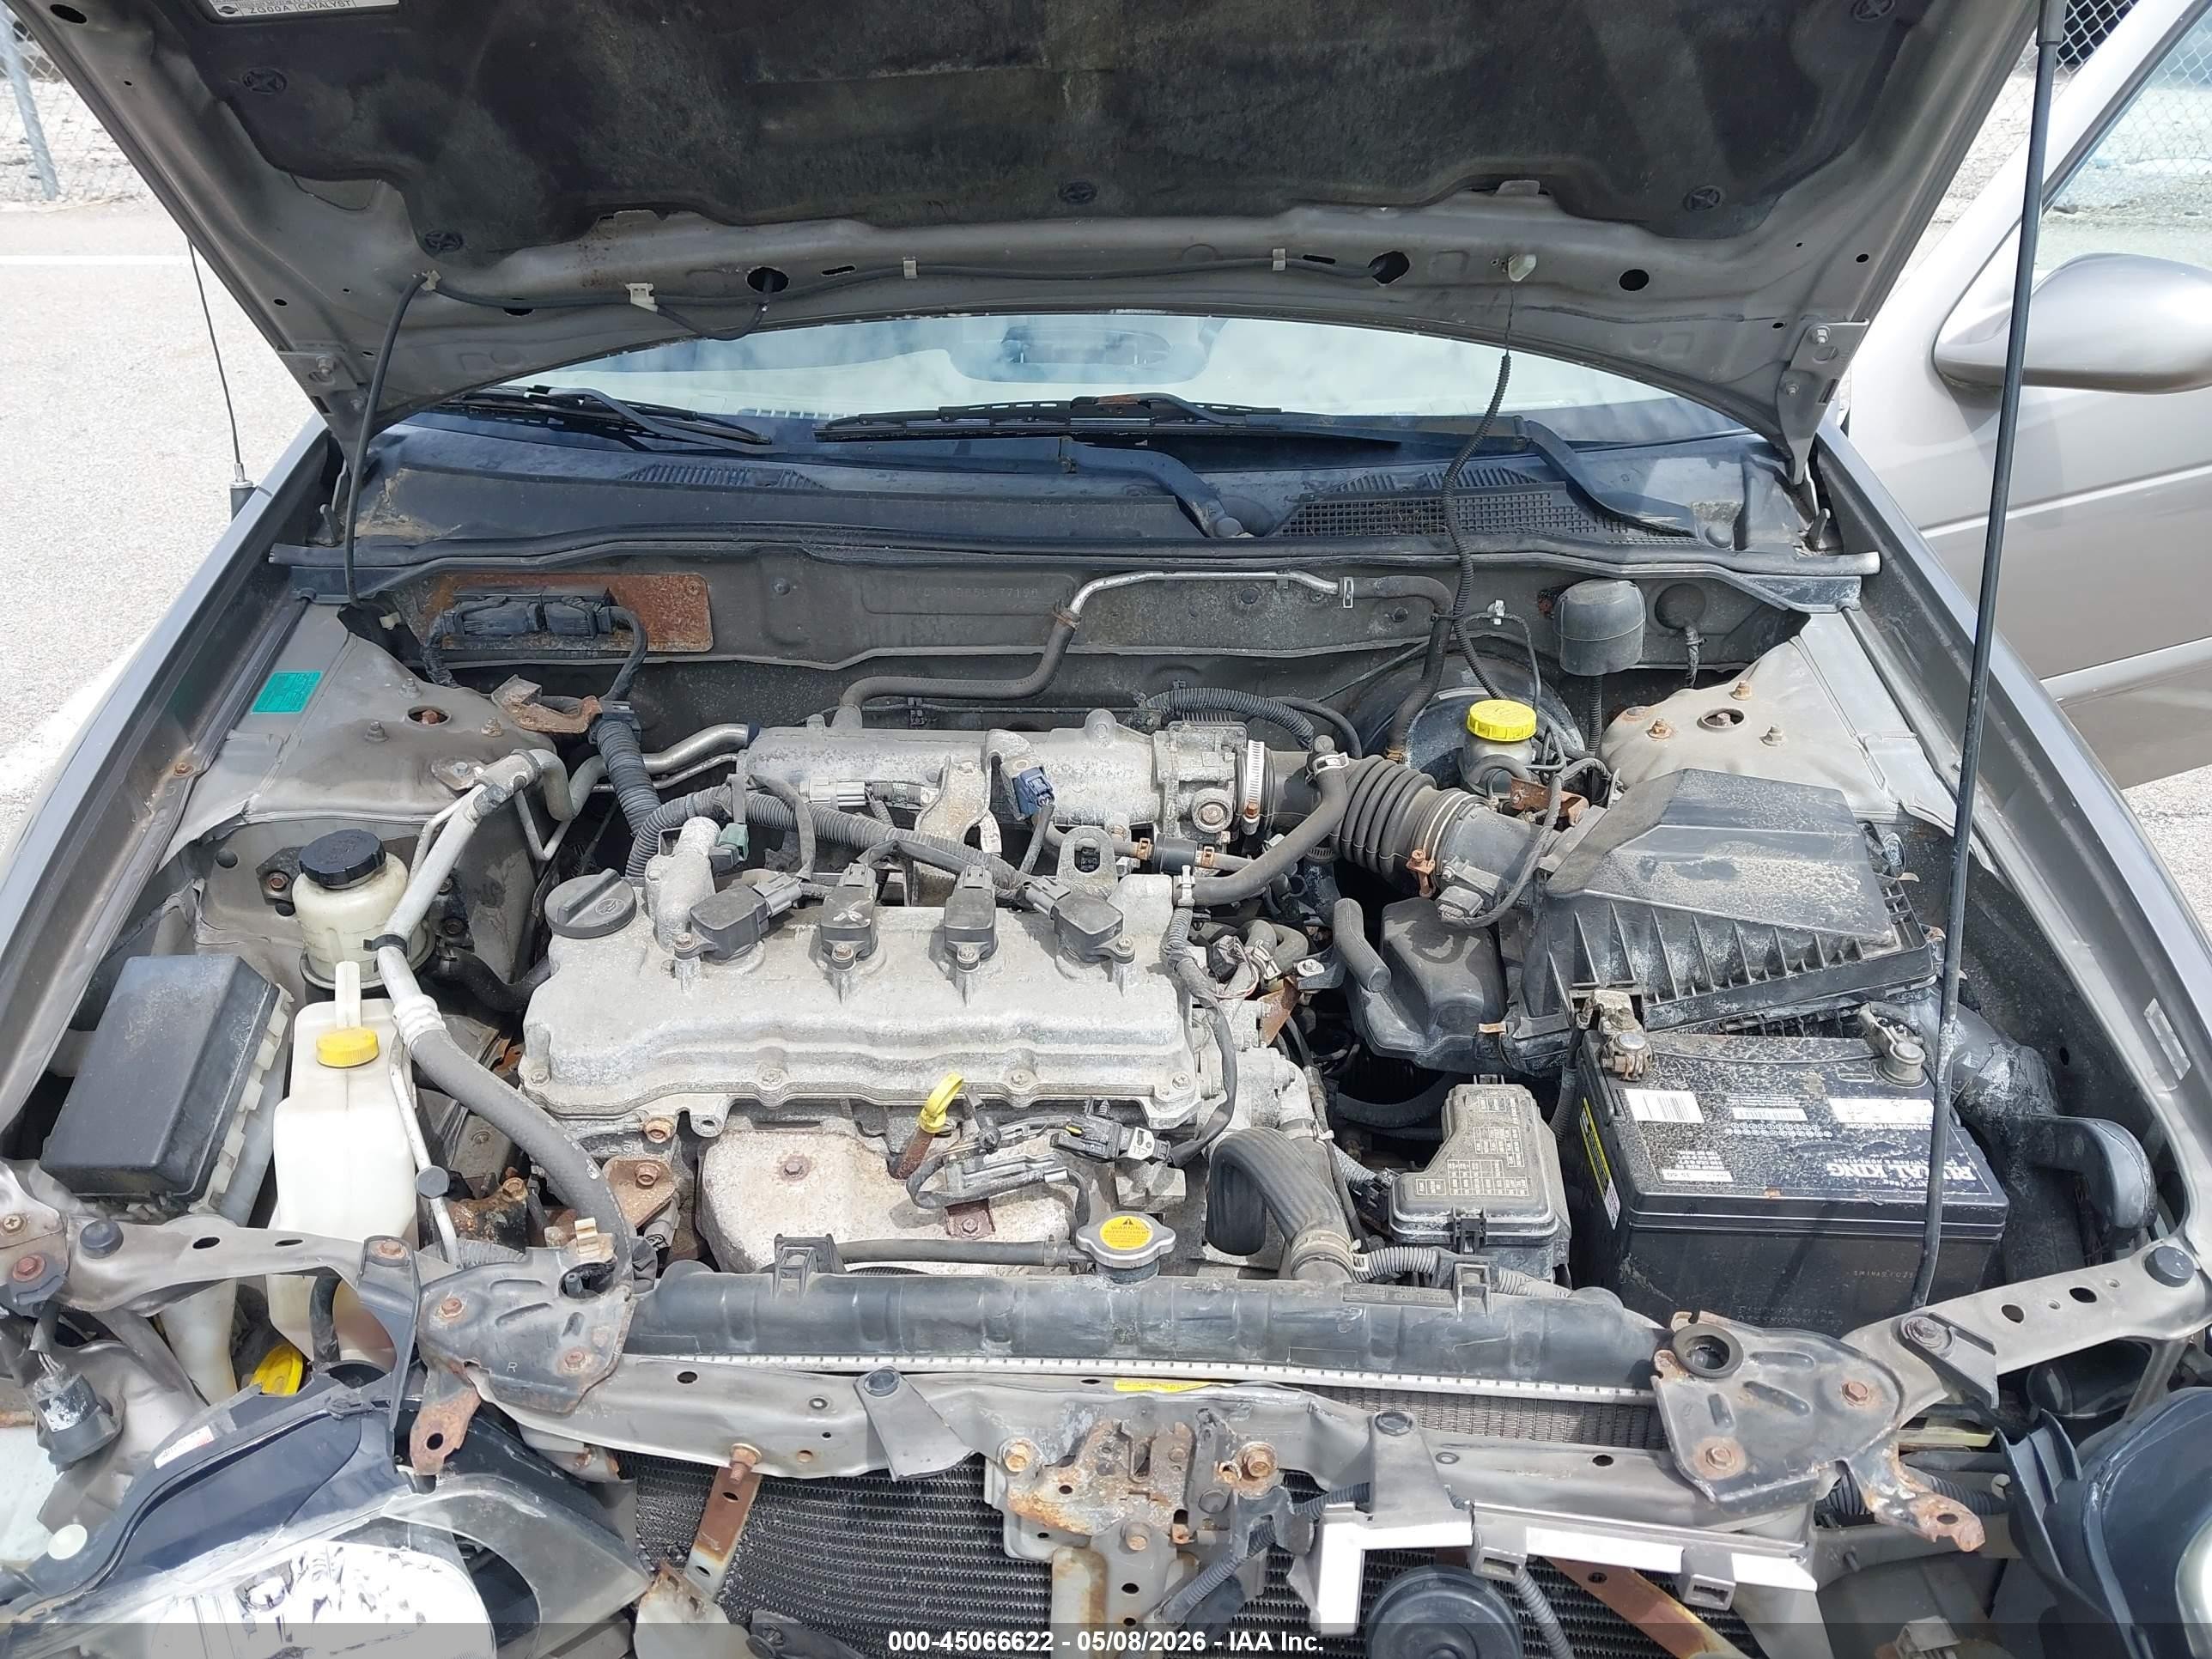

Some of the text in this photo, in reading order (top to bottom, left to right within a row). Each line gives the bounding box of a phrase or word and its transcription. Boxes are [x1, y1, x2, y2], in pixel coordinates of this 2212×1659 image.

[249, 0, 353, 15] ZG00A CATALYST
[1826, 1163, 1887, 1177] KING
[507, 1361, 519, 1373] R
